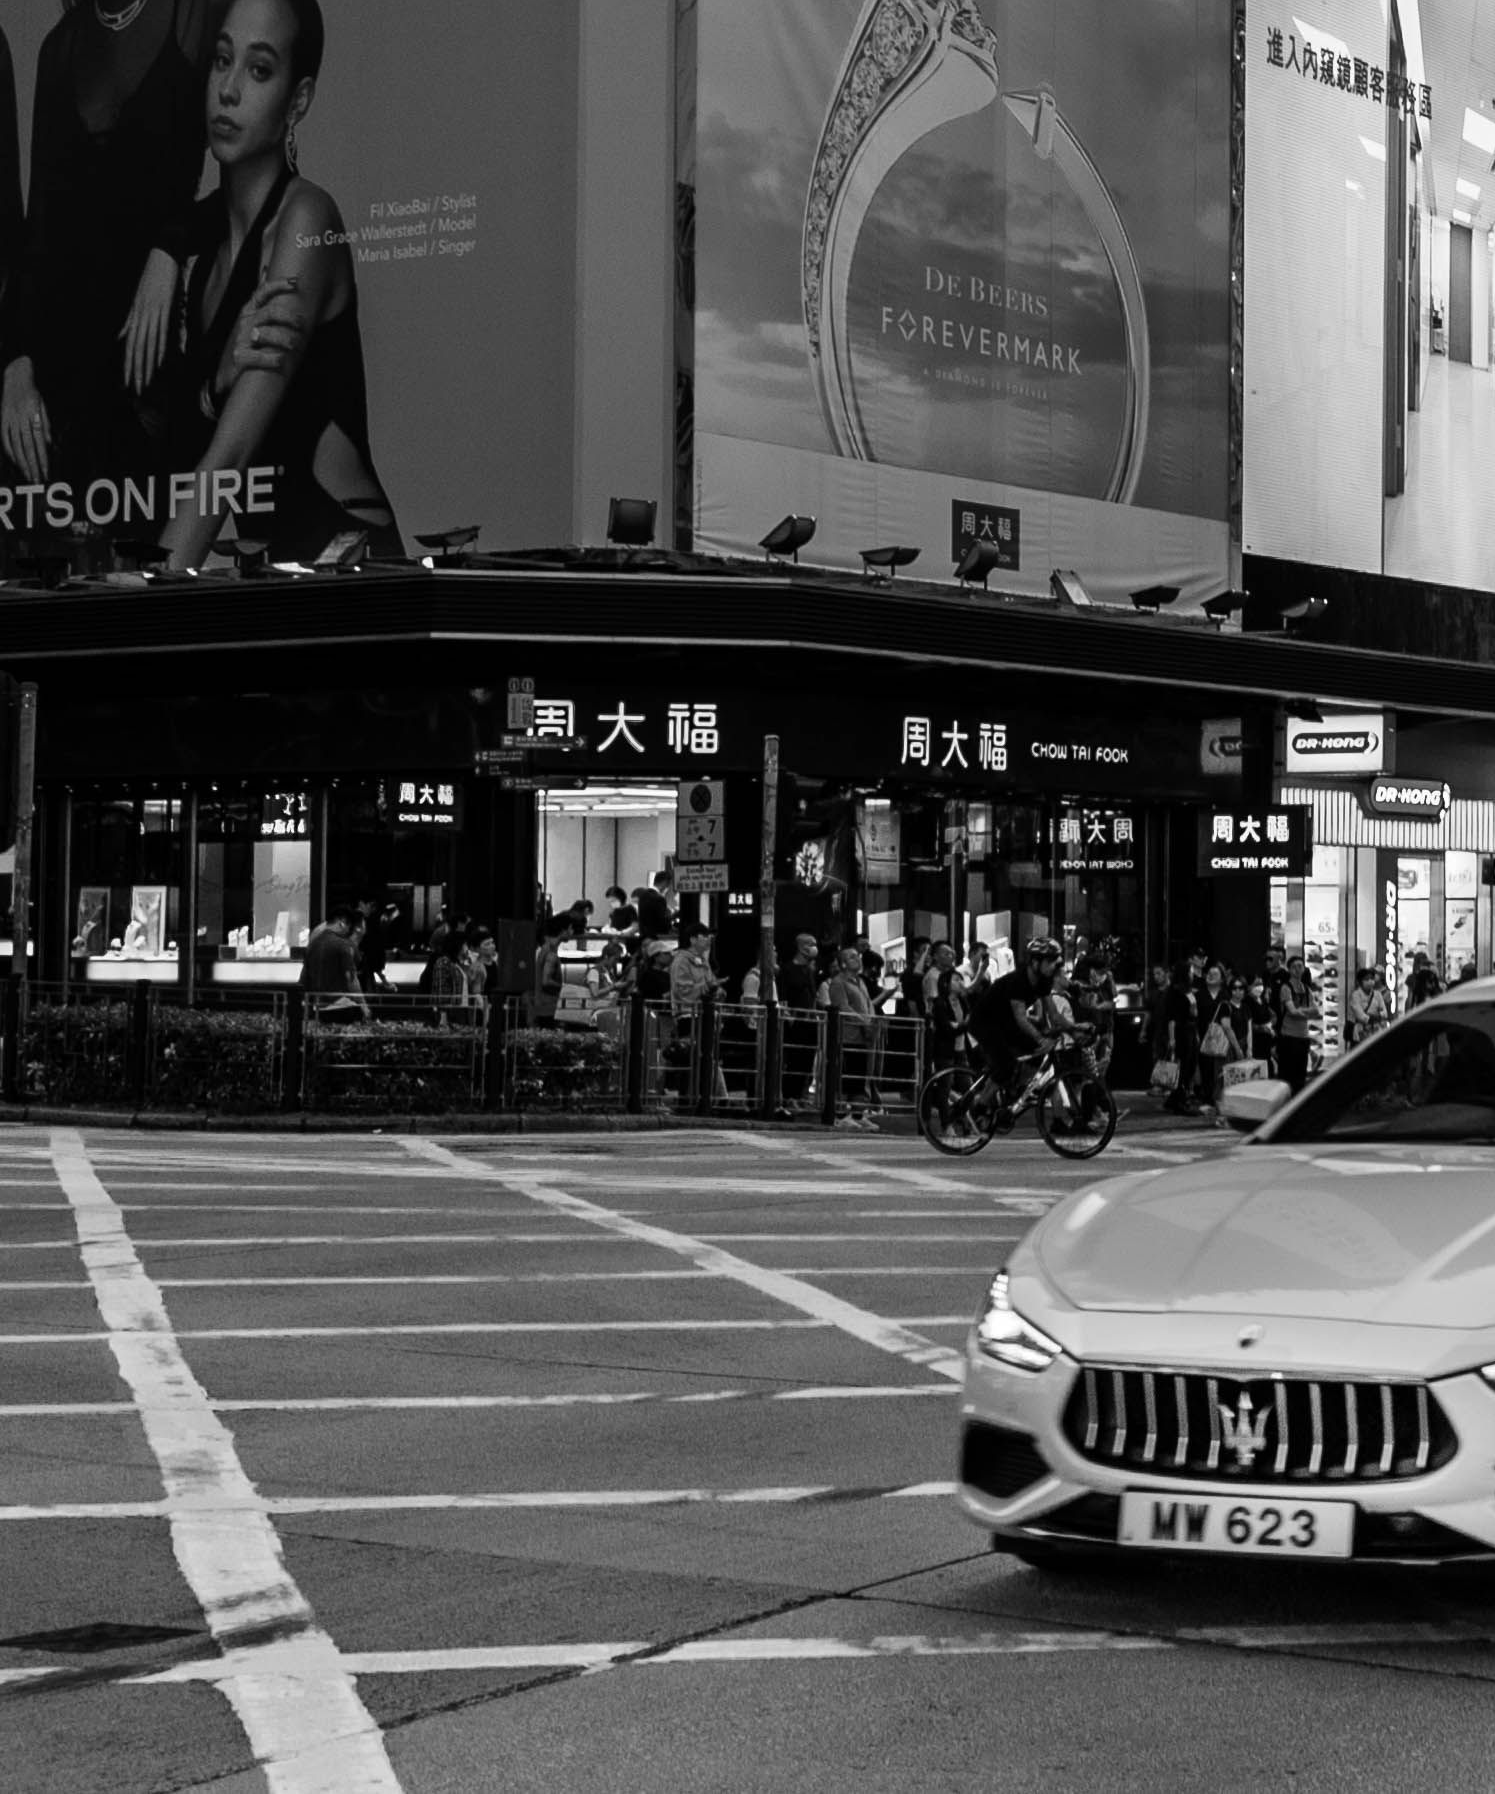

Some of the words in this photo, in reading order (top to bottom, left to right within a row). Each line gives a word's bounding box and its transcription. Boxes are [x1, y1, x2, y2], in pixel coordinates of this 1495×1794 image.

[295, 232, 321, 248] Sara
[324, 229, 358, 246] Grace
[438, 214, 476, 232] Model
[357, 248, 390, 263] Maria
[438, 238, 476, 256] Singer
[924, 265, 962, 298] DE
[970, 275, 1048, 316] BEERS
[85, 474, 156, 525] ON
[168, 465, 276, 519] FIRE
[961, 510, 1013, 541] 周大福
[526, 699, 720, 755] 周大福
[901, 716, 1008, 772] 周大福
[1031, 741, 1068, 760] CHOW
[1072, 744, 1092, 760] TAI
[1095, 746, 1129, 764] FOOK
[399, 782, 454, 806] 周大福
[1212, 814, 1289, 843] 周大福
[1226, 1505, 1318, 1549] 623
